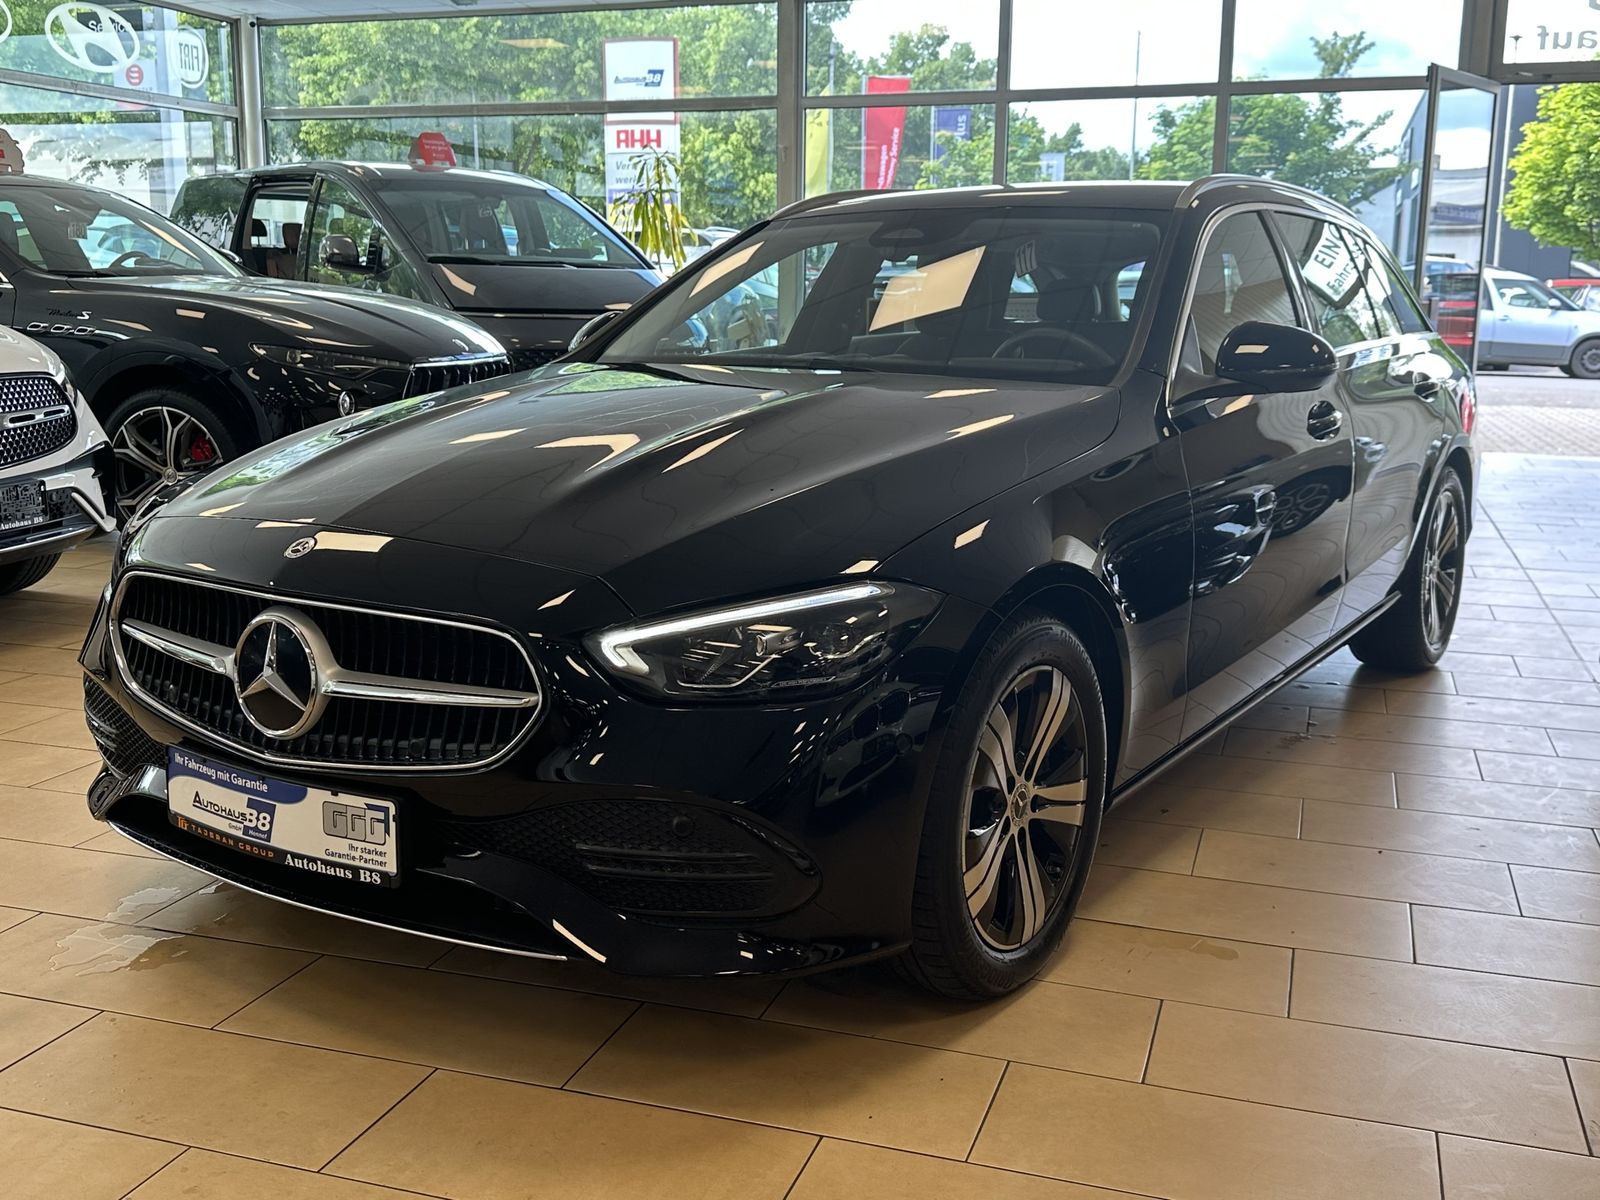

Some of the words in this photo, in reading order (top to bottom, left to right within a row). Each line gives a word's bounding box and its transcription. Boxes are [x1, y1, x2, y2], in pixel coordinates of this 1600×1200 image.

[174, 752, 184, 764] Ihr
[185, 756, 216, 779] Fahrzeug
[217, 769, 231, 782] mit
[231, 773, 268, 792] Garantie
[238, 842, 274, 858] GROUP
[325, 848, 387, 867] Garantie-Partner
[349, 844, 358, 853] Ihr
[360, 847, 387, 858] starker
[285, 854, 352, 879] Autohaus
[359, 869, 381, 885] B8
